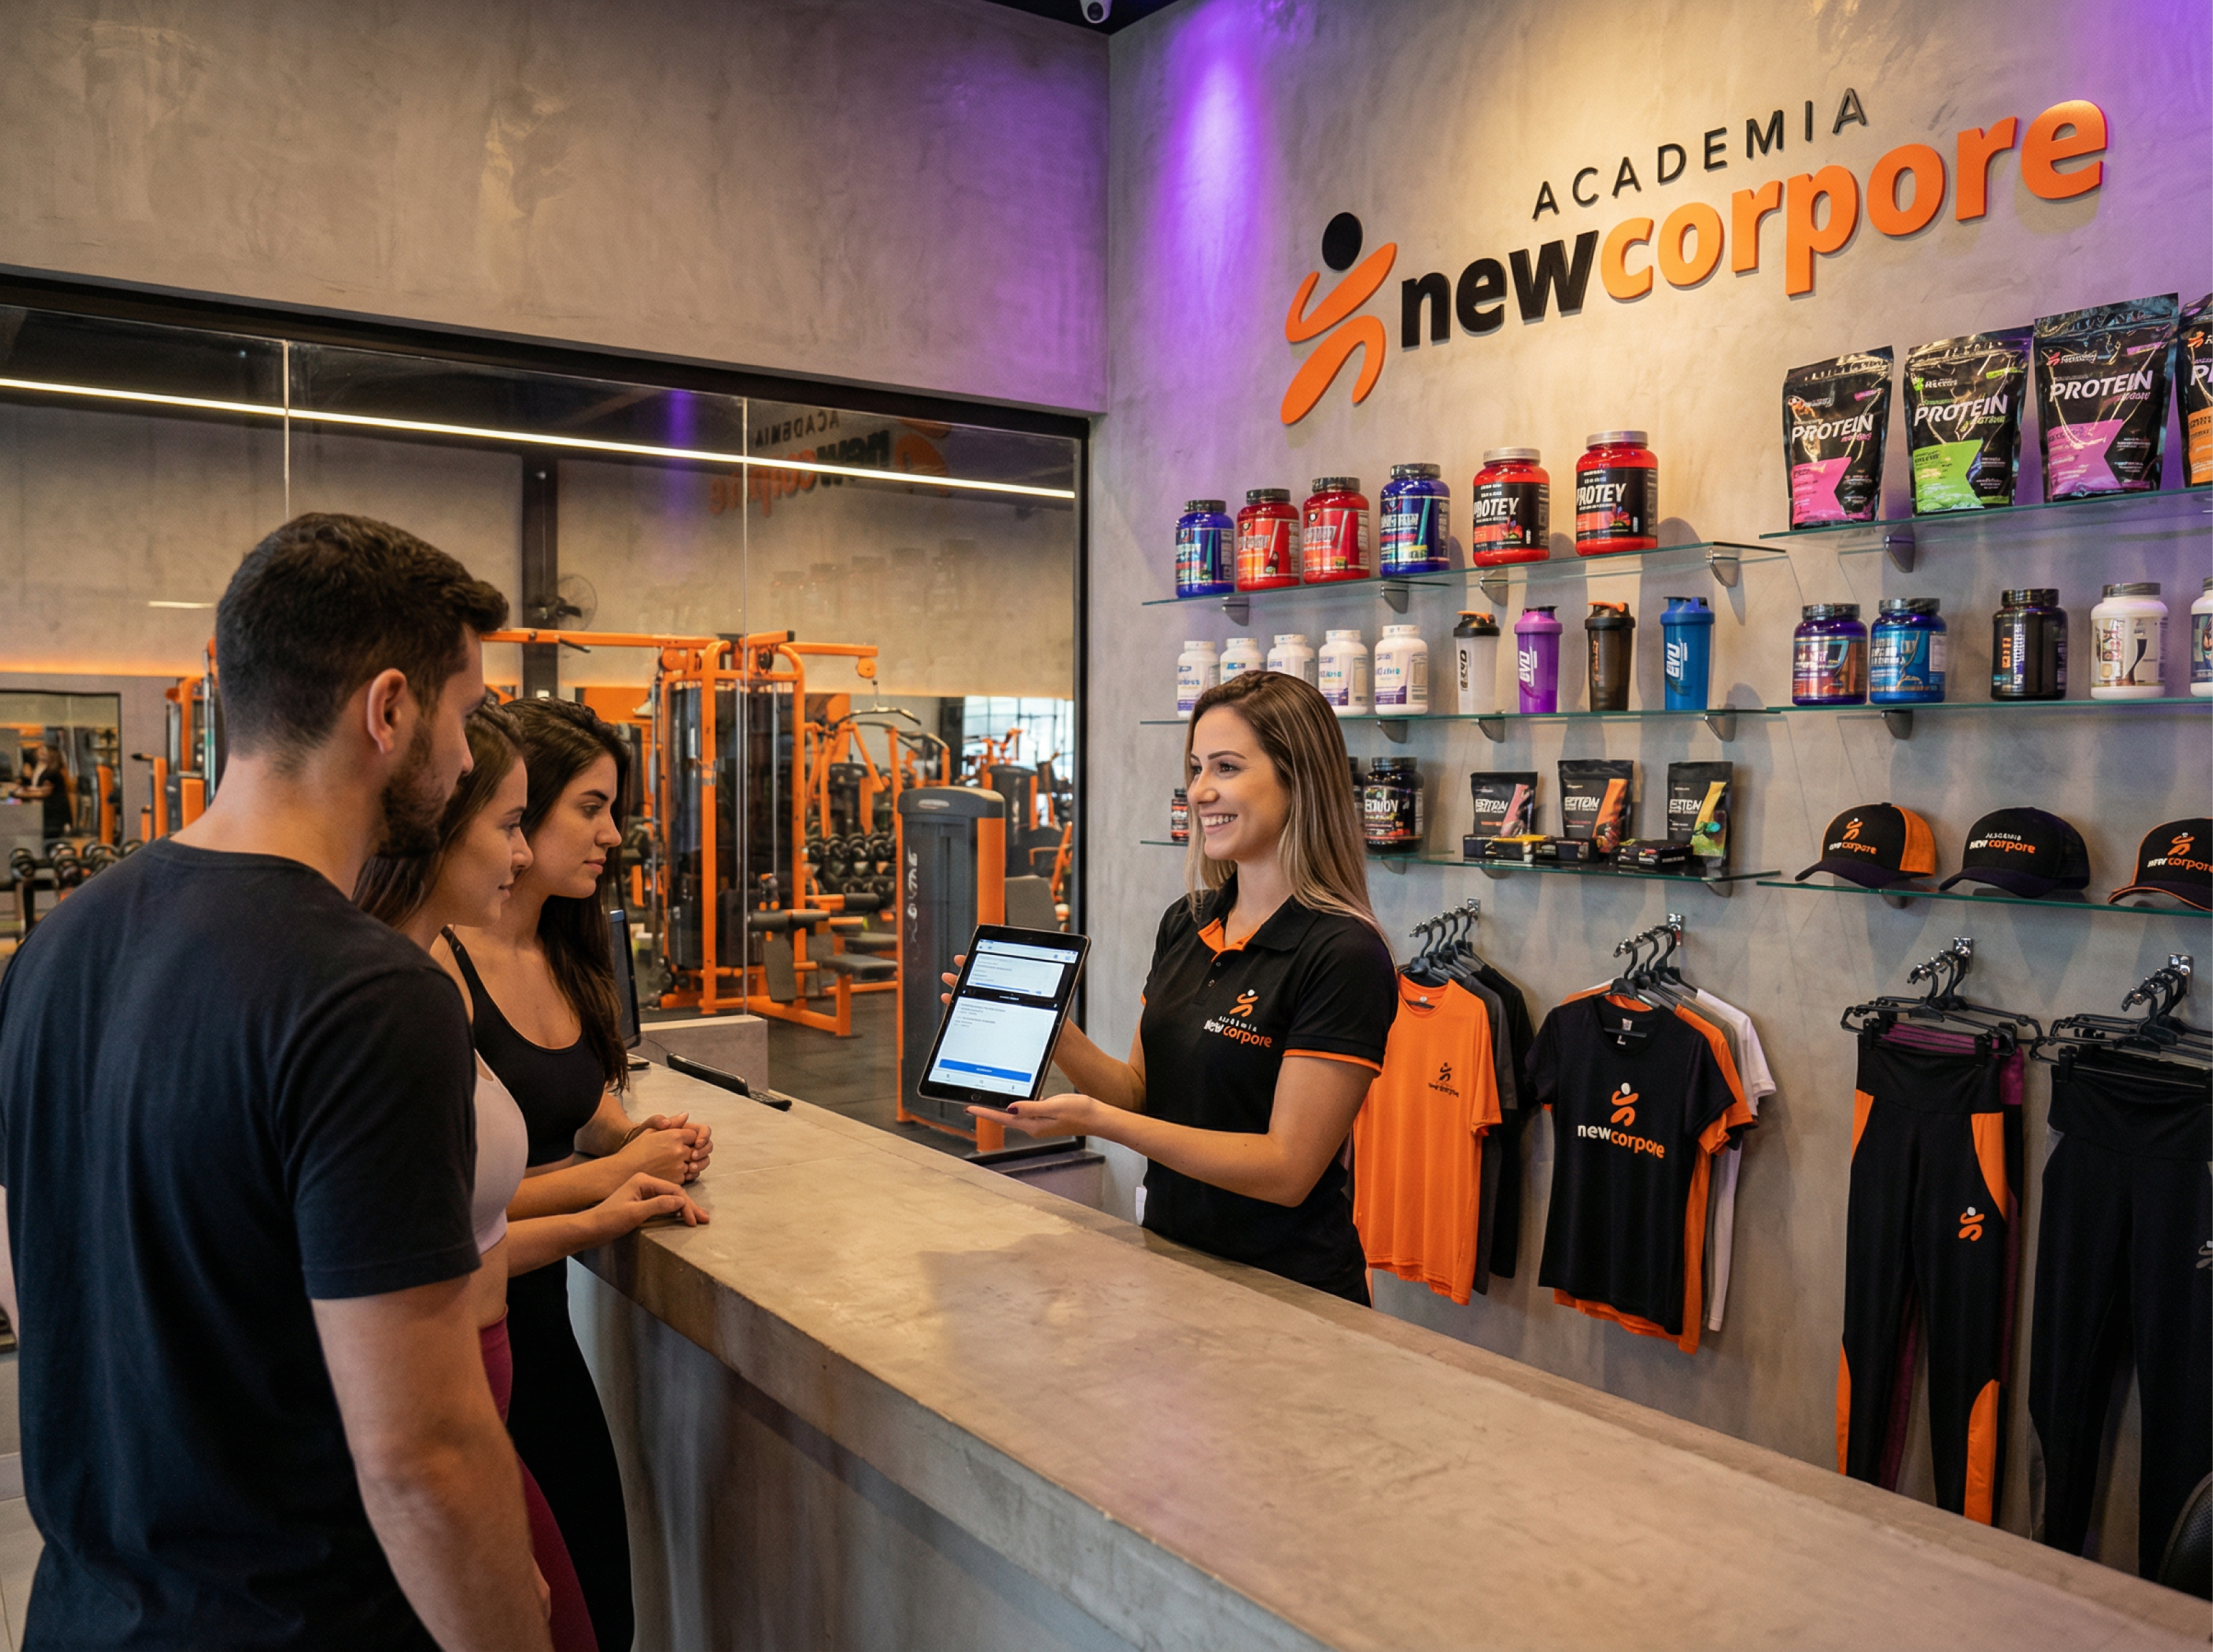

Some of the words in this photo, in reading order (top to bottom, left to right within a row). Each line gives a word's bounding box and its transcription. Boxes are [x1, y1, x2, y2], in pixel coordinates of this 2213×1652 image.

[1531, 88, 1868, 221] ACADEMIA
[1401, 99, 2108, 348] newcorpore
[2049, 370, 2153, 402] PROTEIN
[1914, 394, 2008, 427] PROTEIN
[1792, 414, 1874, 444] PROTEIN
